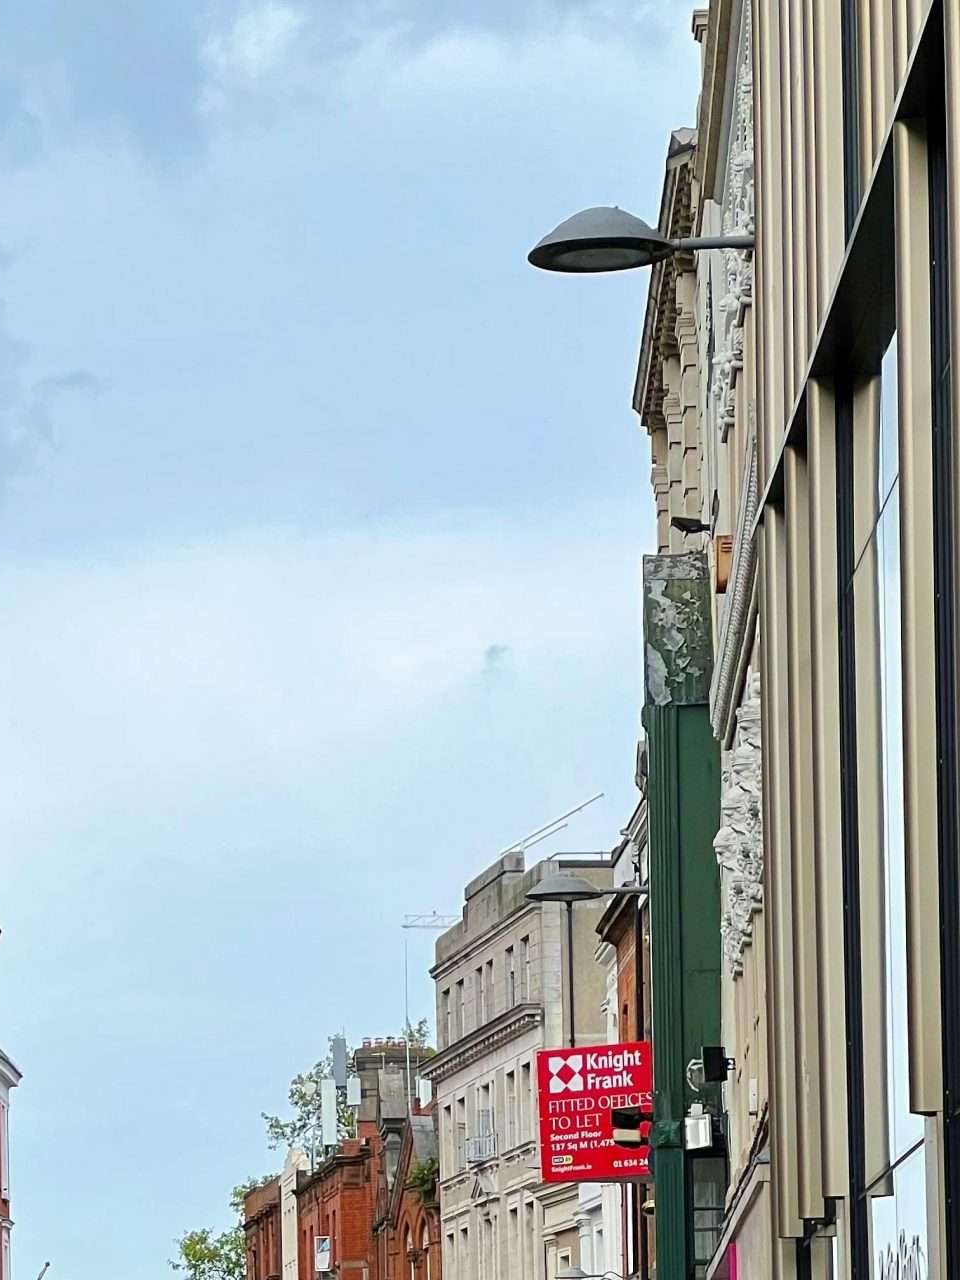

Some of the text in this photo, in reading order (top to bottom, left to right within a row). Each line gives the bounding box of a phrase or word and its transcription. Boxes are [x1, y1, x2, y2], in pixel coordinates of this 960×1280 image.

[586, 1050, 642, 1071] Knight
[587, 1071, 634, 1090] Frank
[548, 1092, 653, 1114] FITTED OFFICES
[549, 1113, 603, 1130] TO LET
[550, 1130, 602, 1141] Second Floor
[551, 1143, 565, 1151] 137
[567, 1141, 578, 1151] Sq
[580, 1141, 588, 1149] M
[624, 1159, 638, 1167] 634
